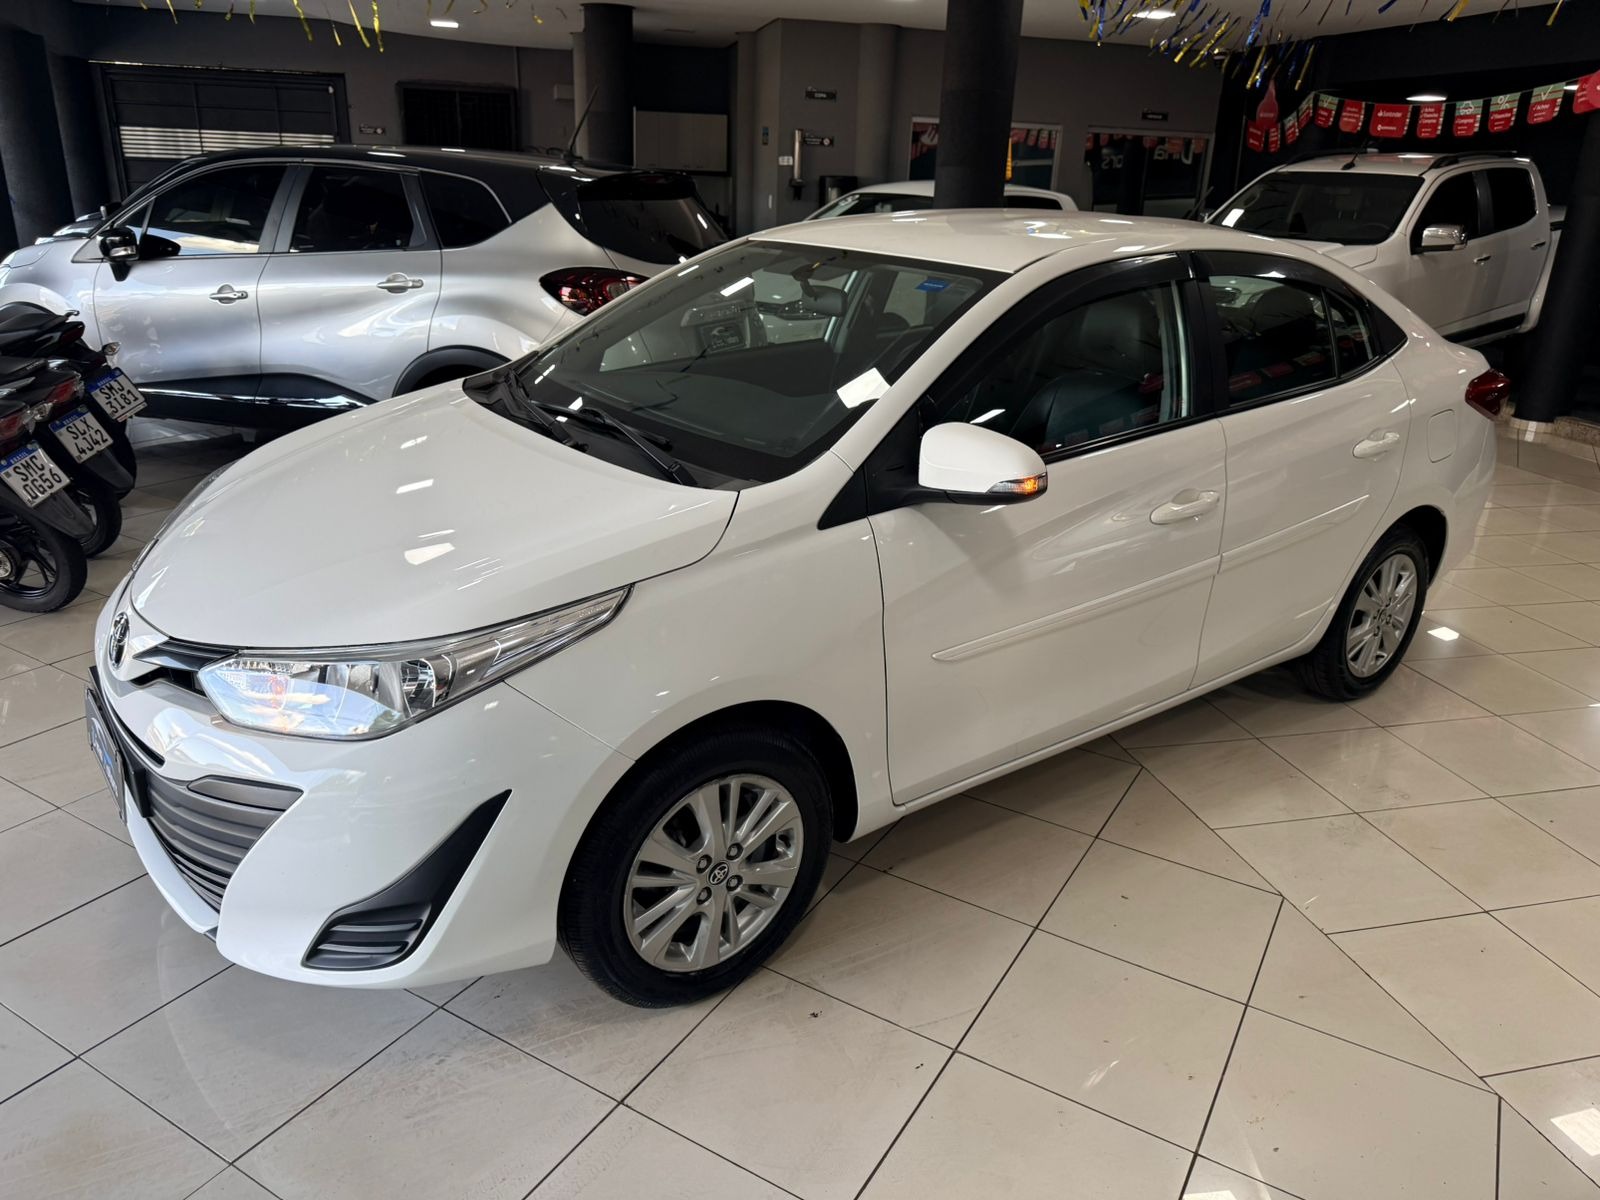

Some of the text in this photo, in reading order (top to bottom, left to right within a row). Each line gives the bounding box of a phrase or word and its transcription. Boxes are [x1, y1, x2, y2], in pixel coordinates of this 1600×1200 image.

[99, 379, 125, 400] SMJ
[66, 418, 94, 441] SLX
[75, 429, 109, 456] 4J42
[13, 455, 45, 482] SMC
